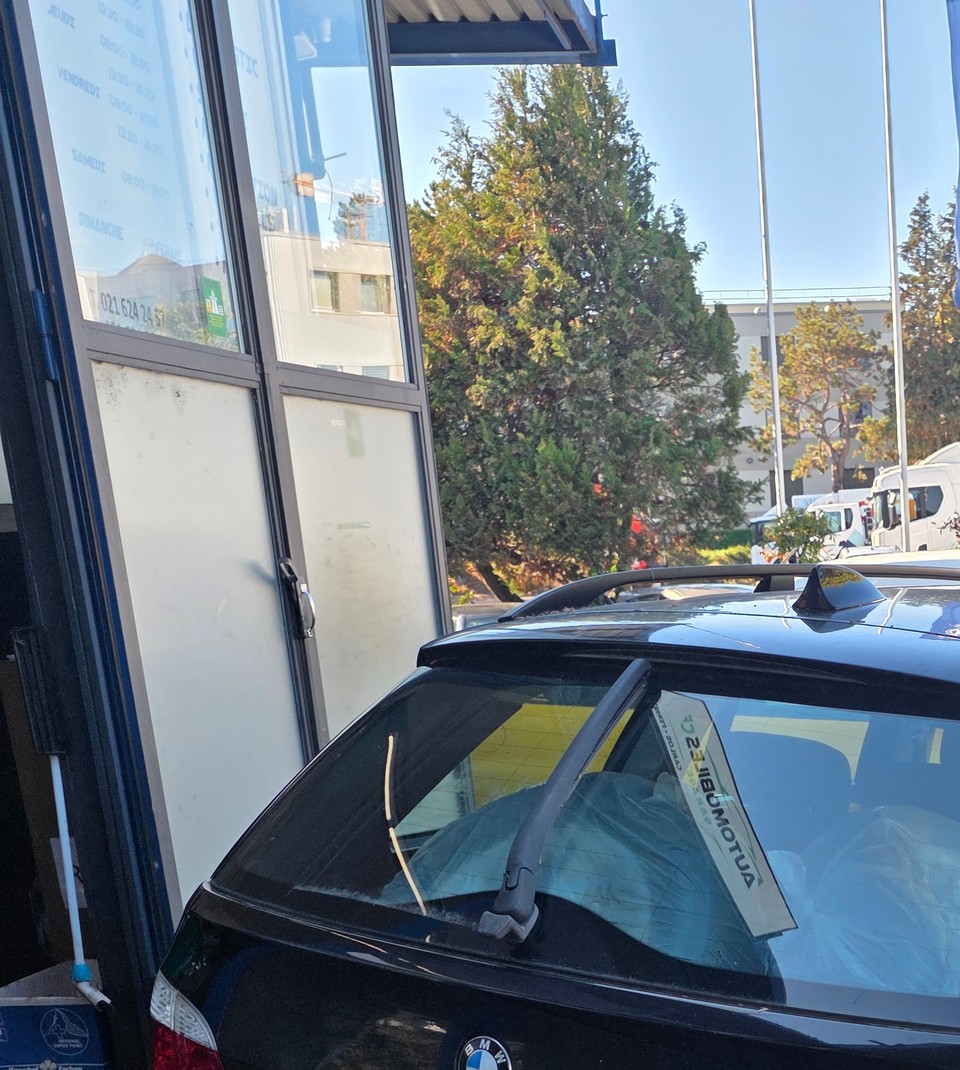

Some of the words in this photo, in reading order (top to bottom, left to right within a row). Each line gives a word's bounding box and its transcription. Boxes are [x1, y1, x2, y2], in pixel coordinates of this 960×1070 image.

[47, 3, 76, 29] JEUDI
[56, 64, 101, 99] VENDREDI
[71, 147, 106, 174] SAMEDI
[78, 211, 124, 241] DIMANCHE
[100, 291, 121, 315] 021
[121, 297, 140, 321] 624
[140, 303, 153, 327] 24
[464, 1038, 507, 1065] BMW
